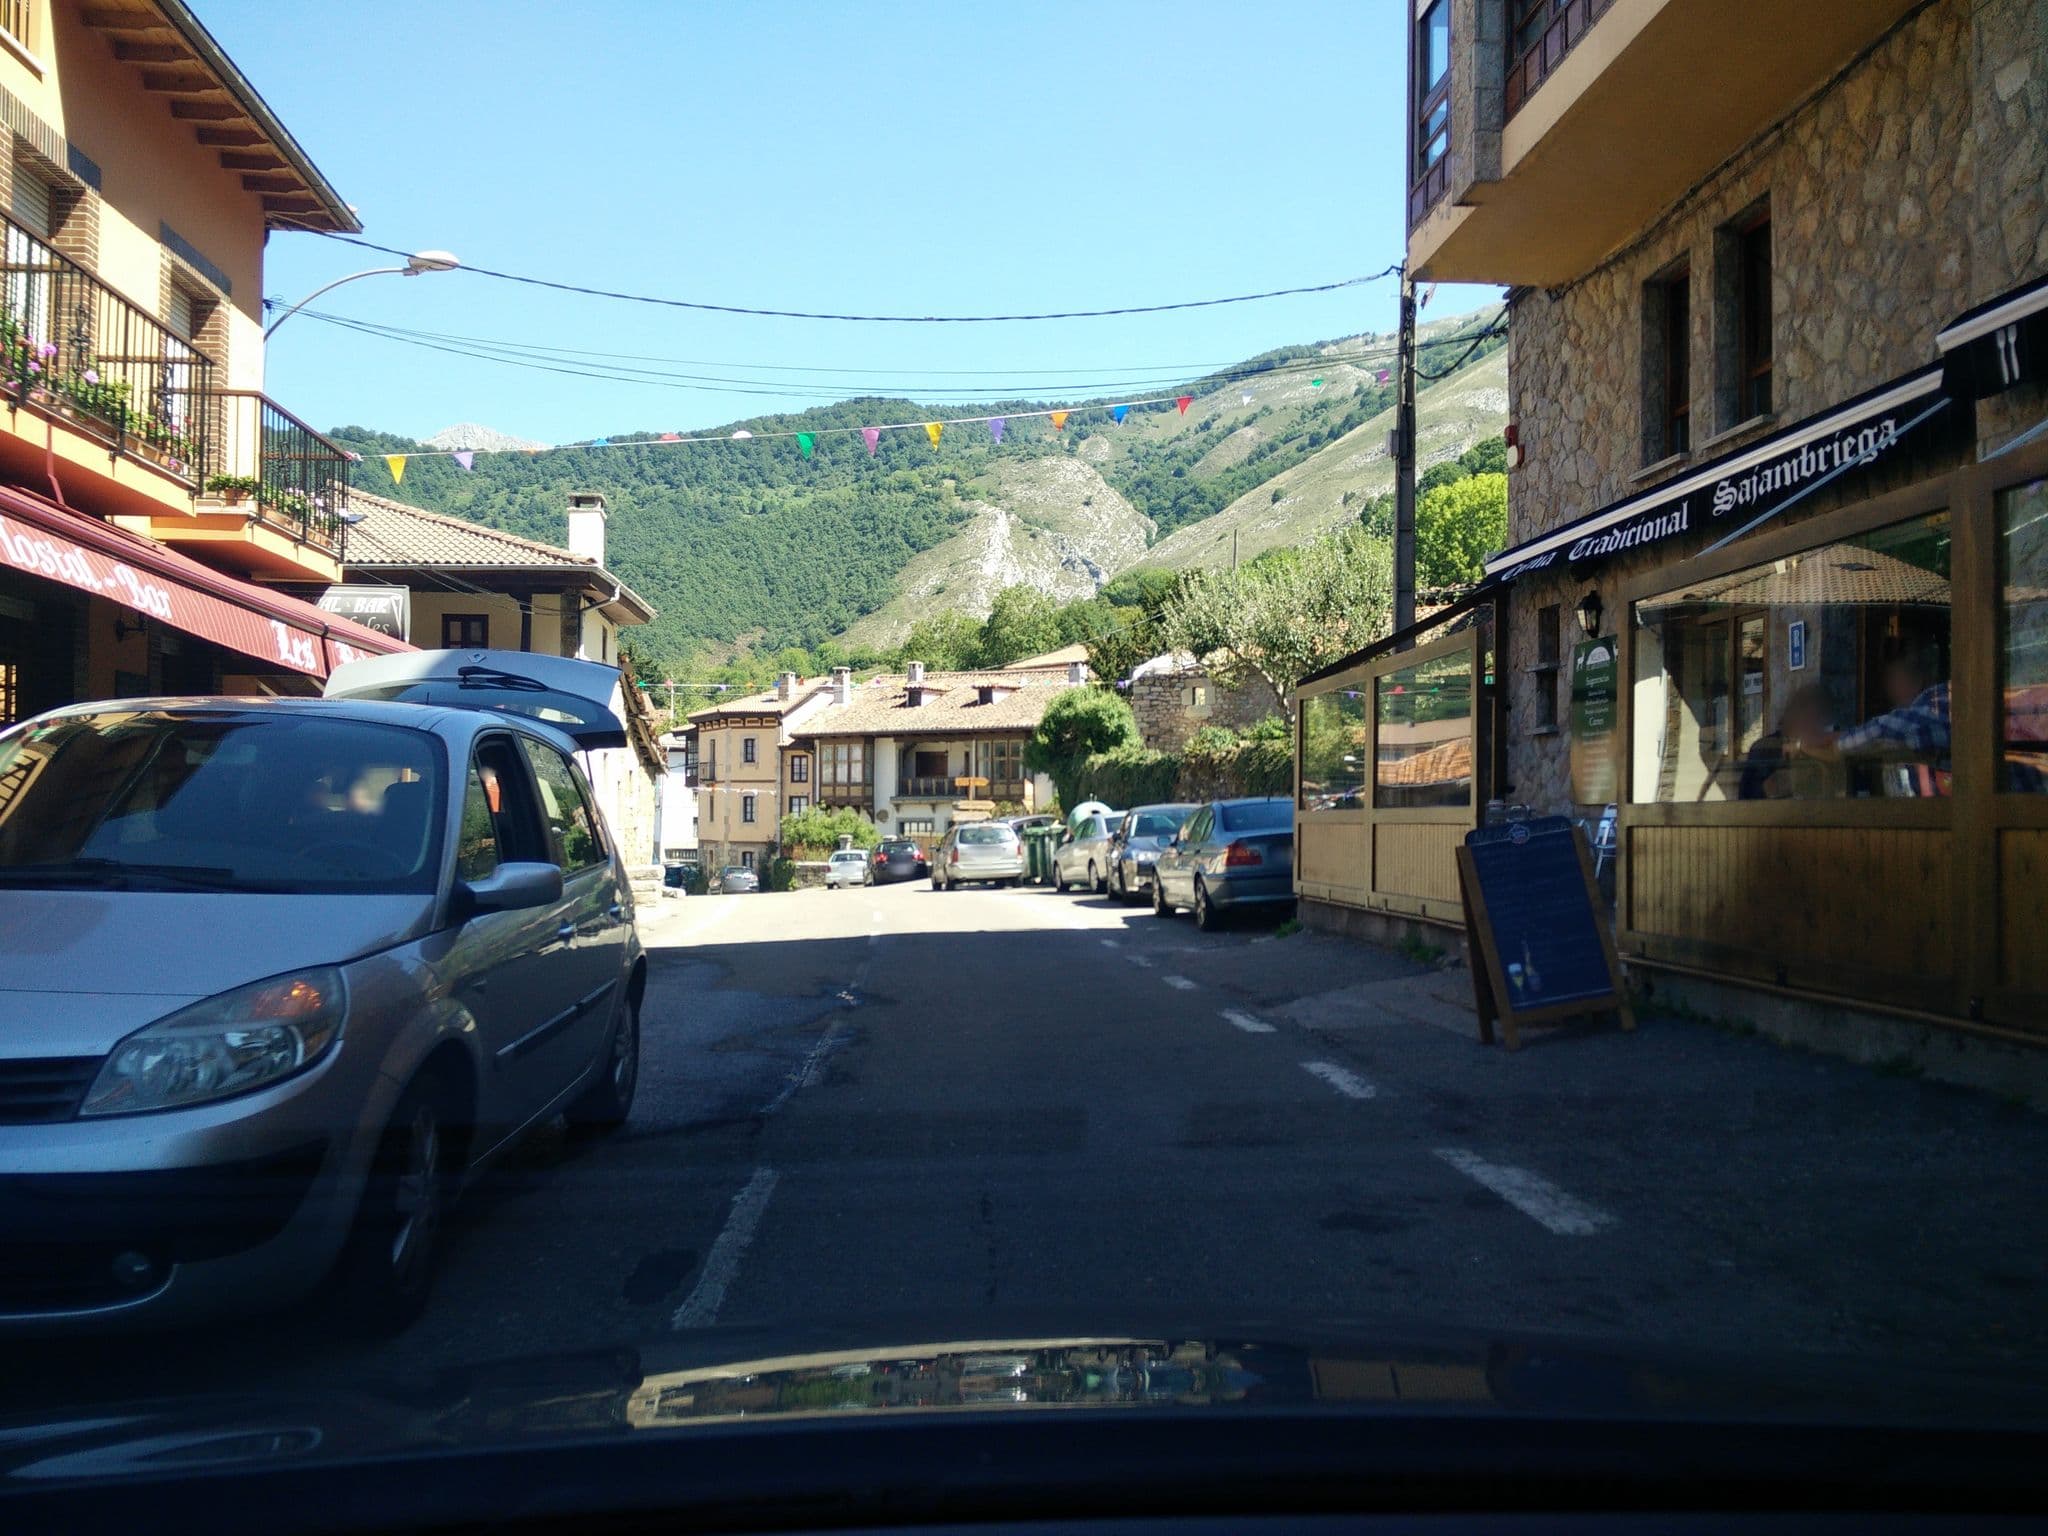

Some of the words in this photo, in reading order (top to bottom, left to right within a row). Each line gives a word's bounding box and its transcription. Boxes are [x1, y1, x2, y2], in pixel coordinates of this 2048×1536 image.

[1568, 501, 1689, 560] Tradicional
[1712, 418, 1899, 517] Sajambriega
[113, 564, 173, 619] Bar
[270, 619, 316, 670] Les
[353, 596, 390, 614] BAR
